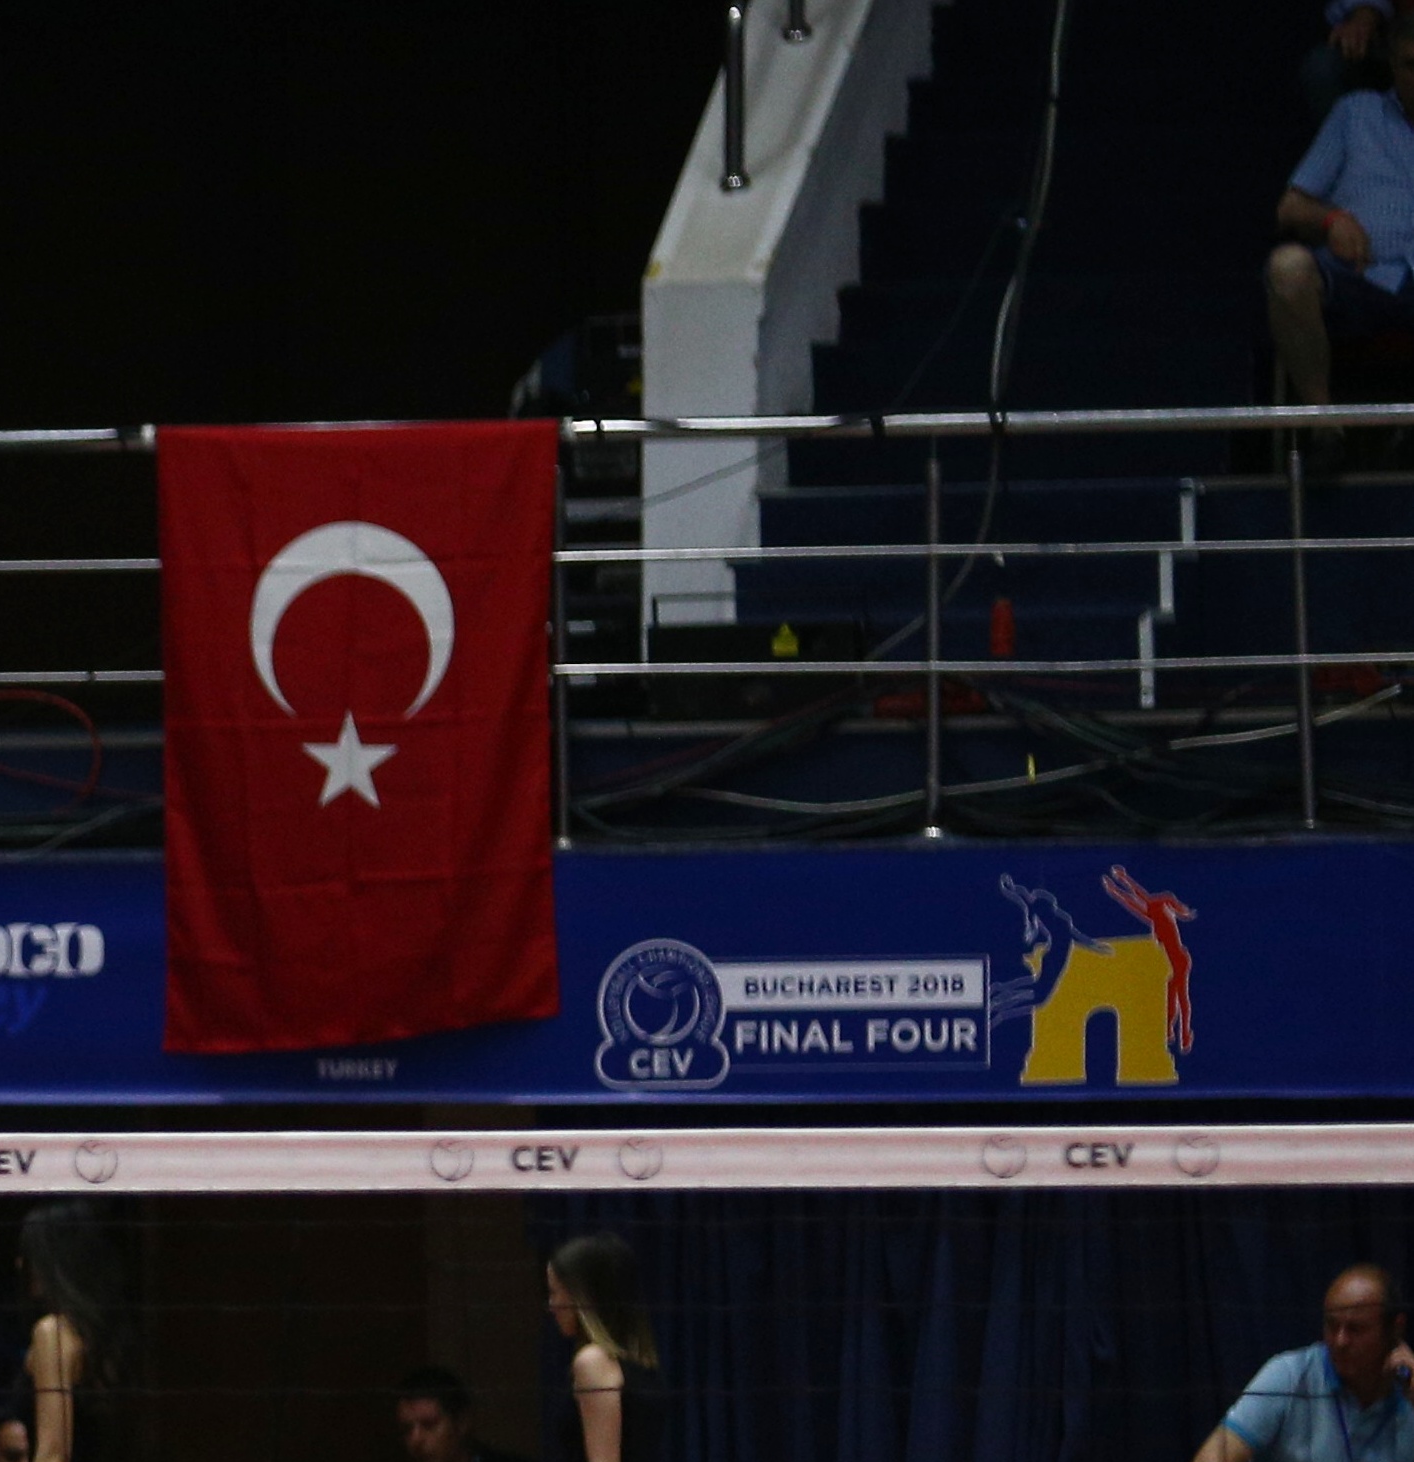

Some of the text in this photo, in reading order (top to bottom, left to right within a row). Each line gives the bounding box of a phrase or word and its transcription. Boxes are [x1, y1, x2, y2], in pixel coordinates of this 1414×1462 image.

[744, 973, 965, 998] BUCHAREST 2018
[734, 1017, 978, 1055] FINAL FOUR
[629, 1048, 694, 1079] CEV
[512, 1146, 580, 1173] CEV
[1064, 1143, 1134, 1170] CEV
